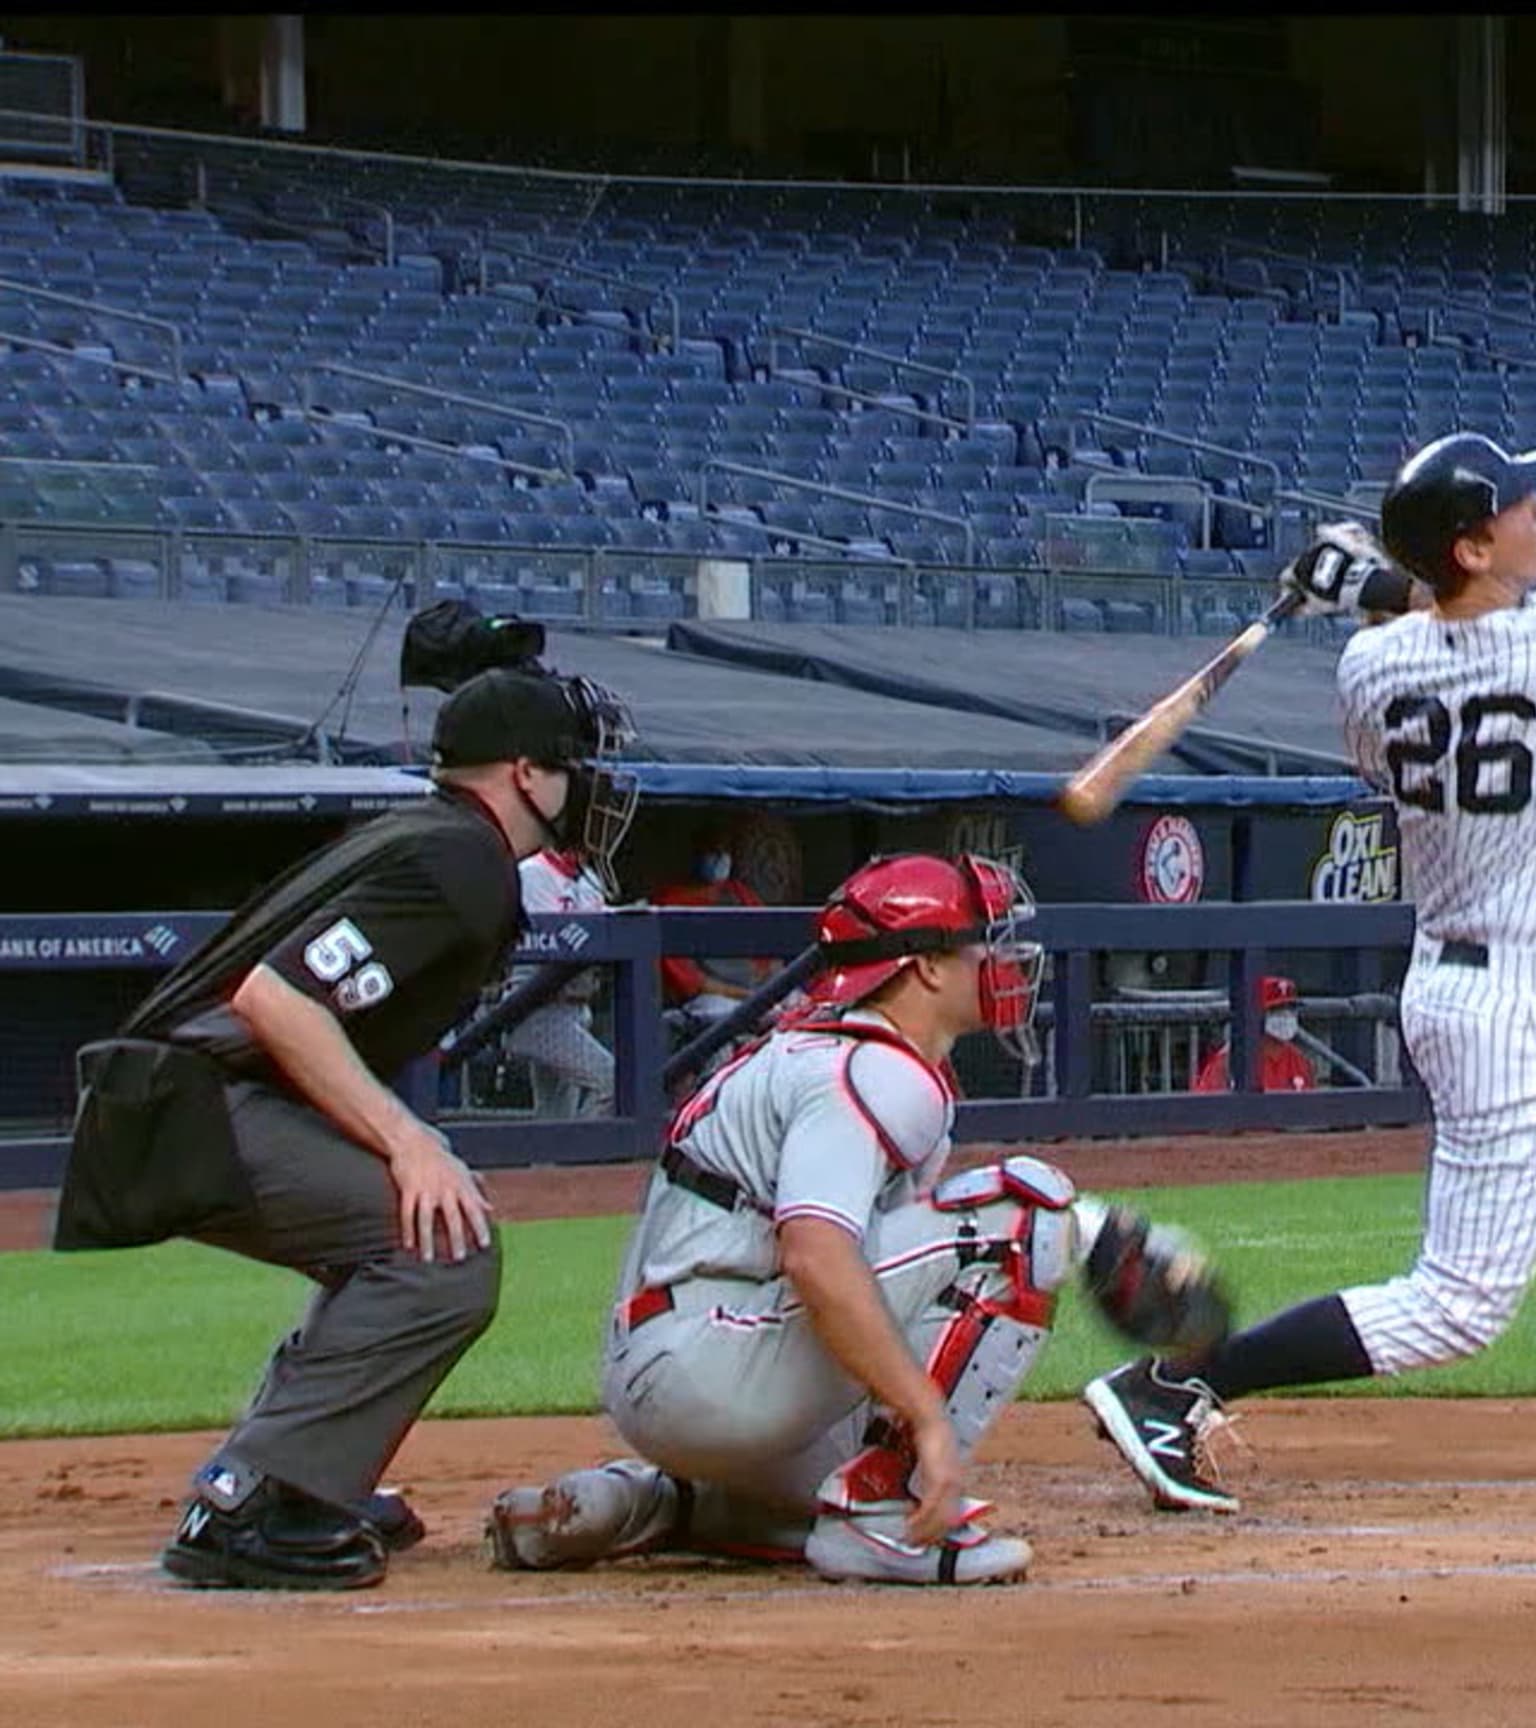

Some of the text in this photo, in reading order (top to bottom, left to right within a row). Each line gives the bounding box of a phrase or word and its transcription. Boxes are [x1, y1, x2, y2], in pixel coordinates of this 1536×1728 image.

[1334, 819, 1381, 866] OXI
[1313, 856, 1395, 901] CLEAN
[0, 939, 37, 957] ANK
[64, 938, 144, 957] AMERICA
